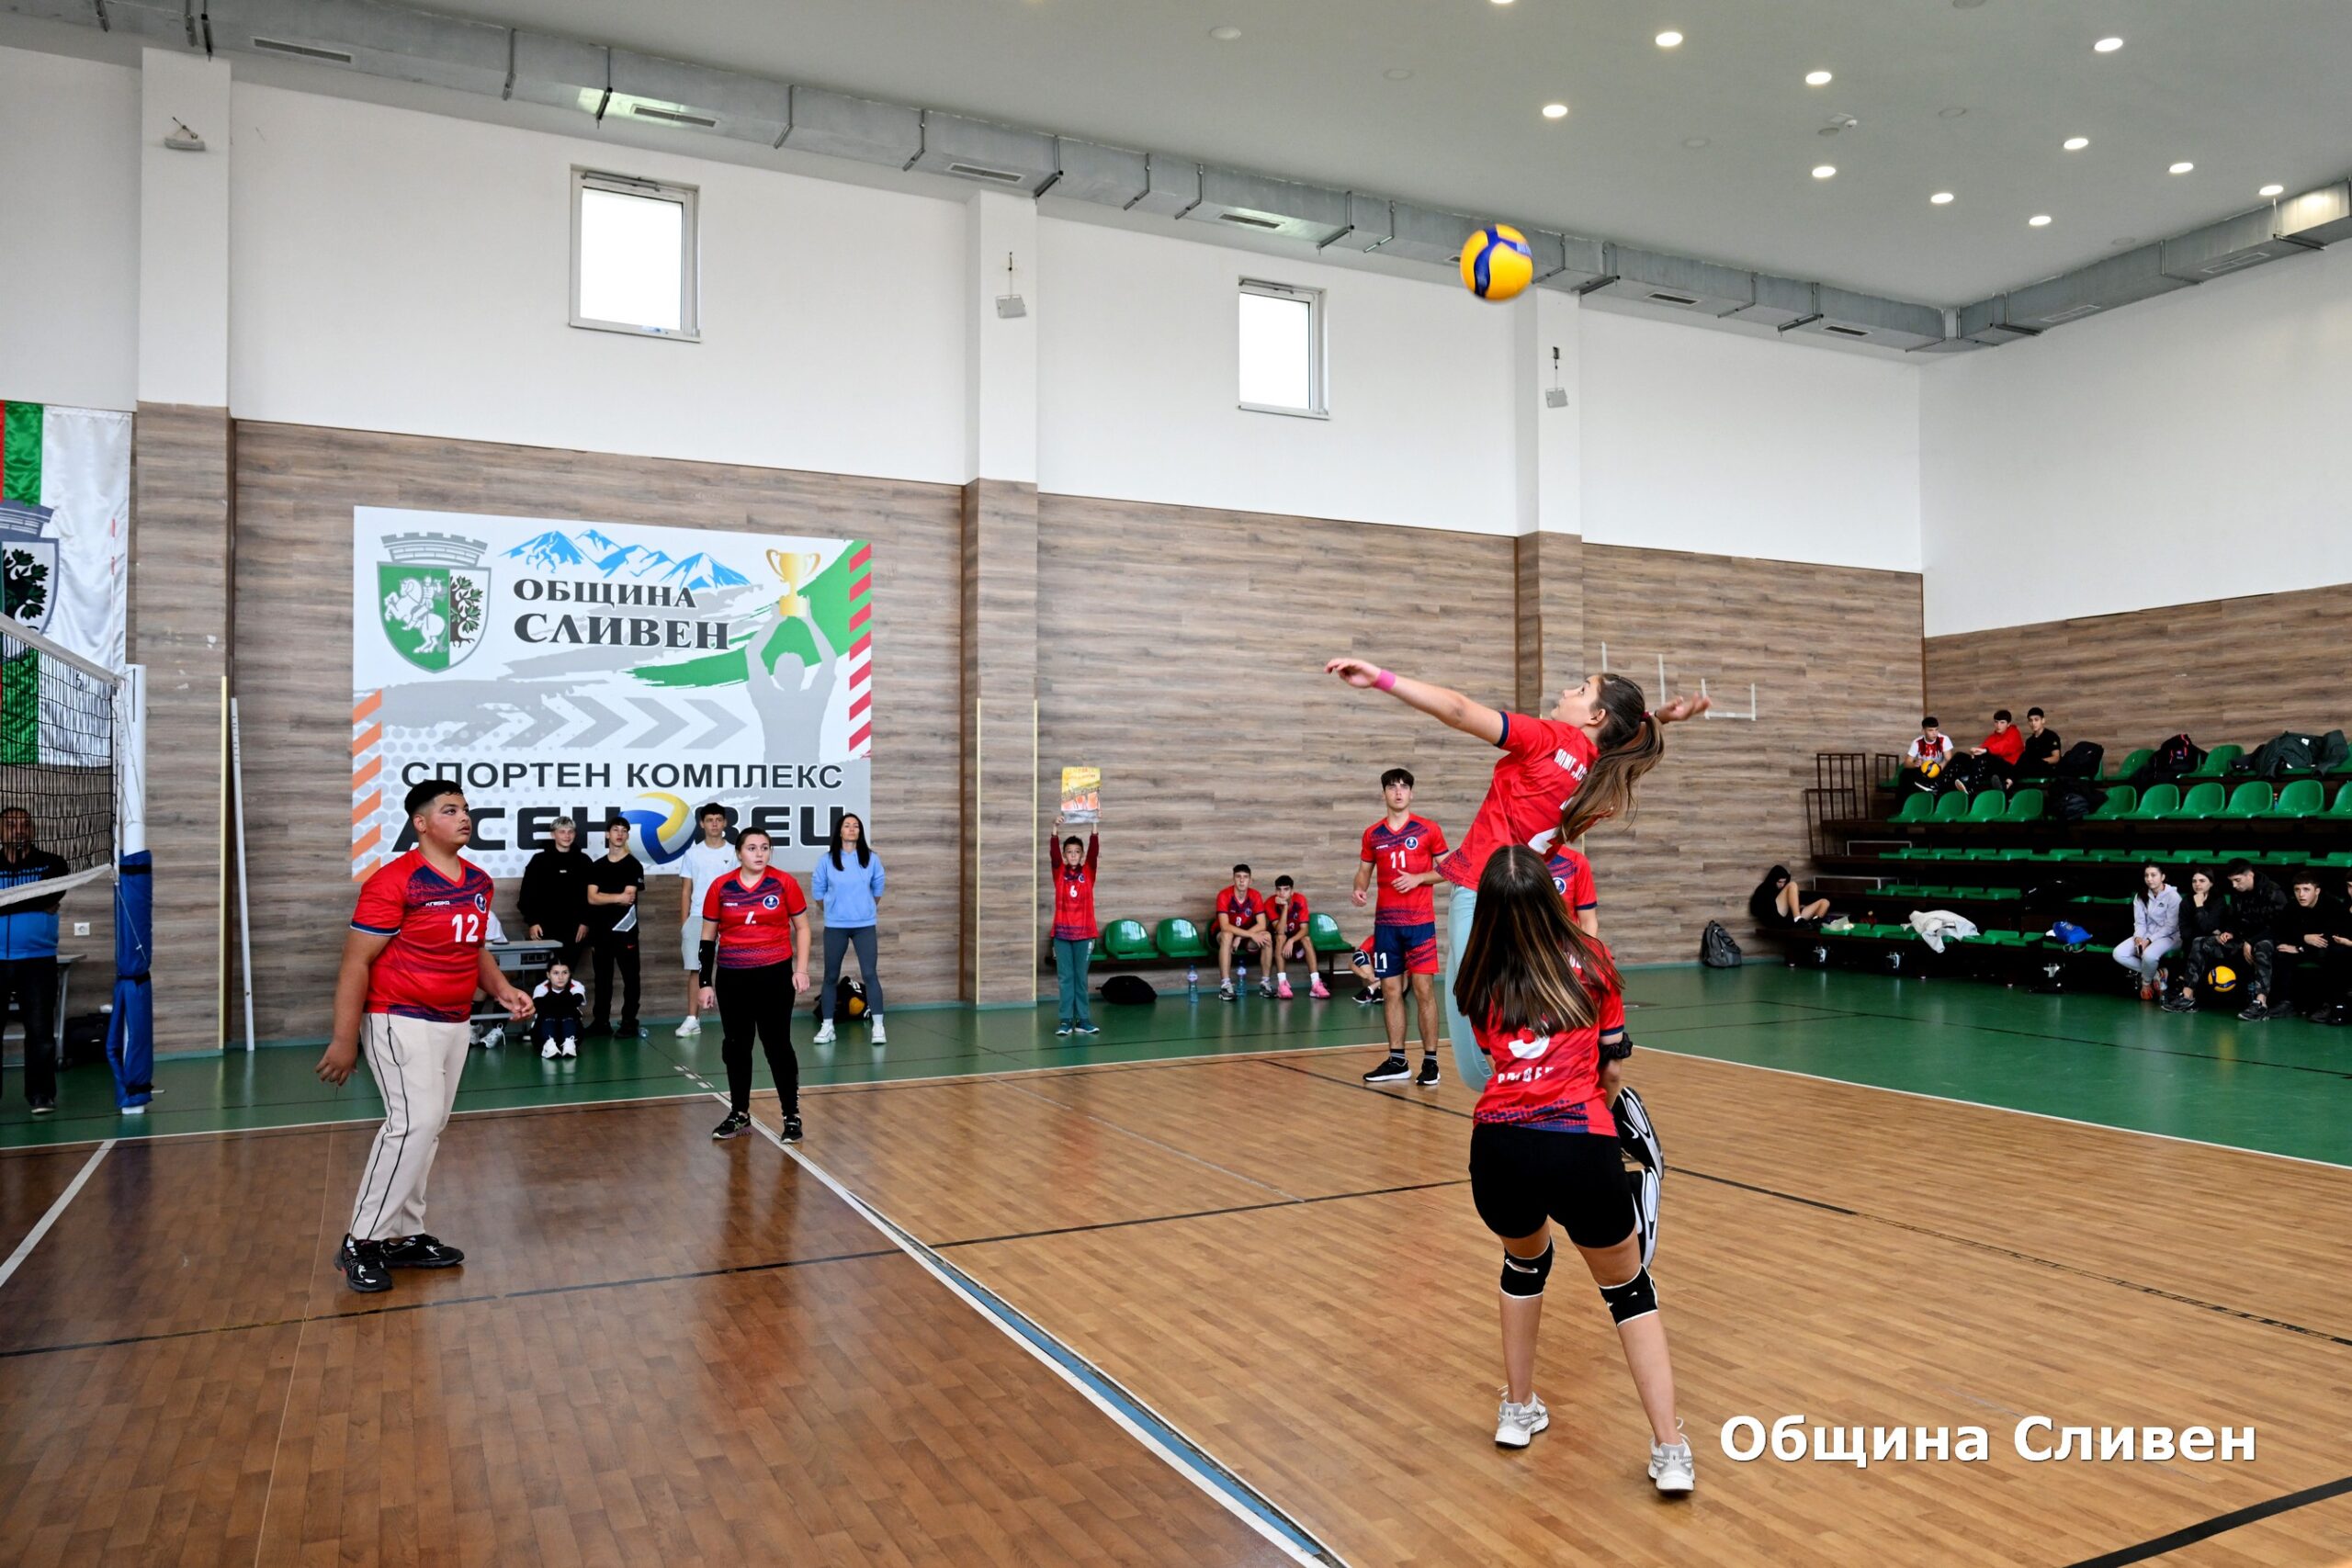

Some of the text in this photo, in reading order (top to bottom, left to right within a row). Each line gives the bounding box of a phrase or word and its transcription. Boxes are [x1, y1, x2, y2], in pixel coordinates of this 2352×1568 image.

[513, 578, 697, 610] ОБЩИНА
[514, 613, 730, 650] СЛИВЕН
[401, 761, 843, 790] СПОРТЕН КОМПЛЕКС
[1390, 850, 1407, 869] 11
[1069, 885, 1078, 898] 6
[451, 913, 481, 943] 12
[1235, 916, 1242, 927] 8
